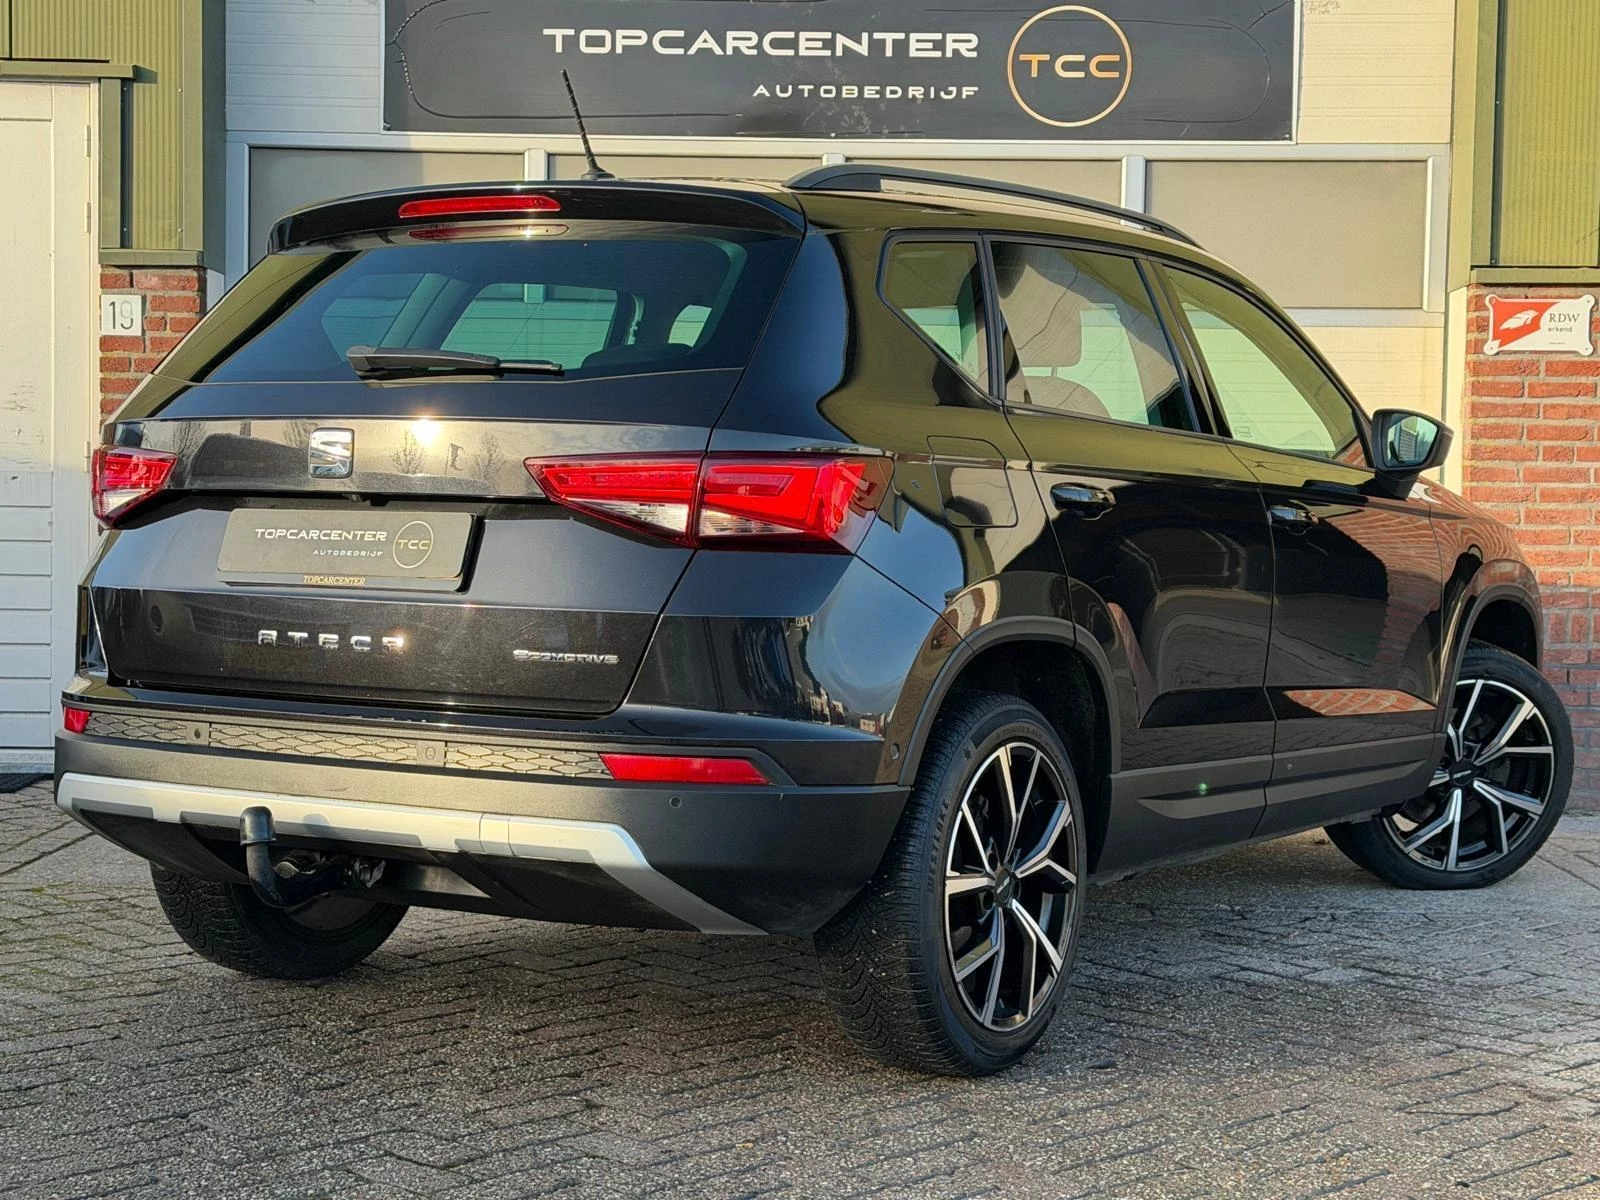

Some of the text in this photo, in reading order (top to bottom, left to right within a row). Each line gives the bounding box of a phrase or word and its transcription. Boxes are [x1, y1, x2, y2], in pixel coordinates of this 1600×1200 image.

[543, 28, 978, 58] TOPCARCENTER
[1019, 53, 1120, 78] TCC
[752, 84, 979, 100] AUTOBEDRIJF
[108, 300, 134, 330] 19
[1549, 312, 1580, 323] RDW
[255, 528, 387, 542] TOPCARCENTER
[397, 538, 430, 550] TCC
[313, 549, 383, 557] AUTOBEDRIJF
[303, 575, 366, 586] TOPCARCENTER
[257, 629, 404, 653] ATECA
